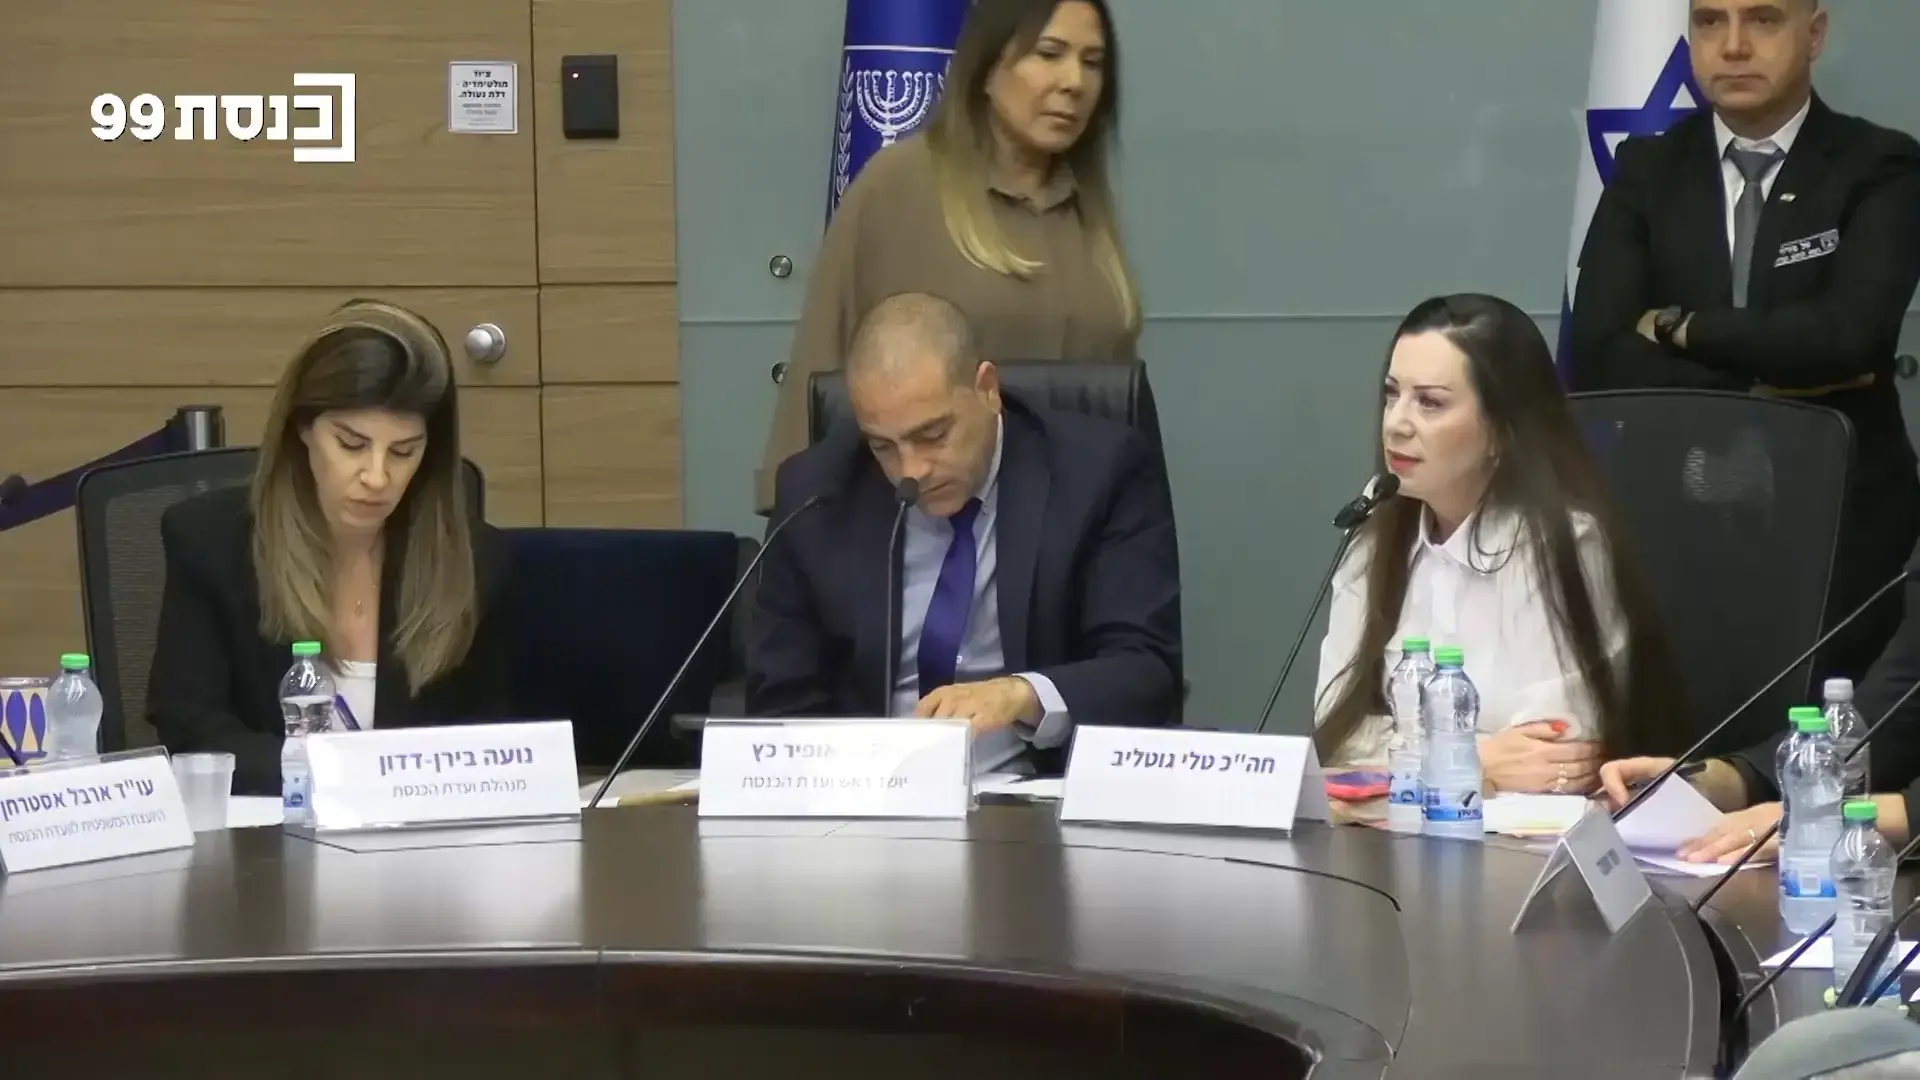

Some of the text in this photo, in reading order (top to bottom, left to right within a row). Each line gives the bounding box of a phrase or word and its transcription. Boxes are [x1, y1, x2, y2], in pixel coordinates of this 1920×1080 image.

[488, 90, 506, 98] דלת
[379, 747, 533, 776] נועה בירן-דדון
[752, 743, 836, 762] אופיר כץ
[1111, 748, 1176, 769] גוטליב
[1181, 750, 1215, 770] טלי
[393, 778, 527, 798] מנהלת ועדת הכנסת
[741, 774, 792, 789] הכנסת
[66, 784, 112, 806] ארבל
[0, 791, 67, 822] אסטרחן
[8, 828, 44, 844] הכנסת
